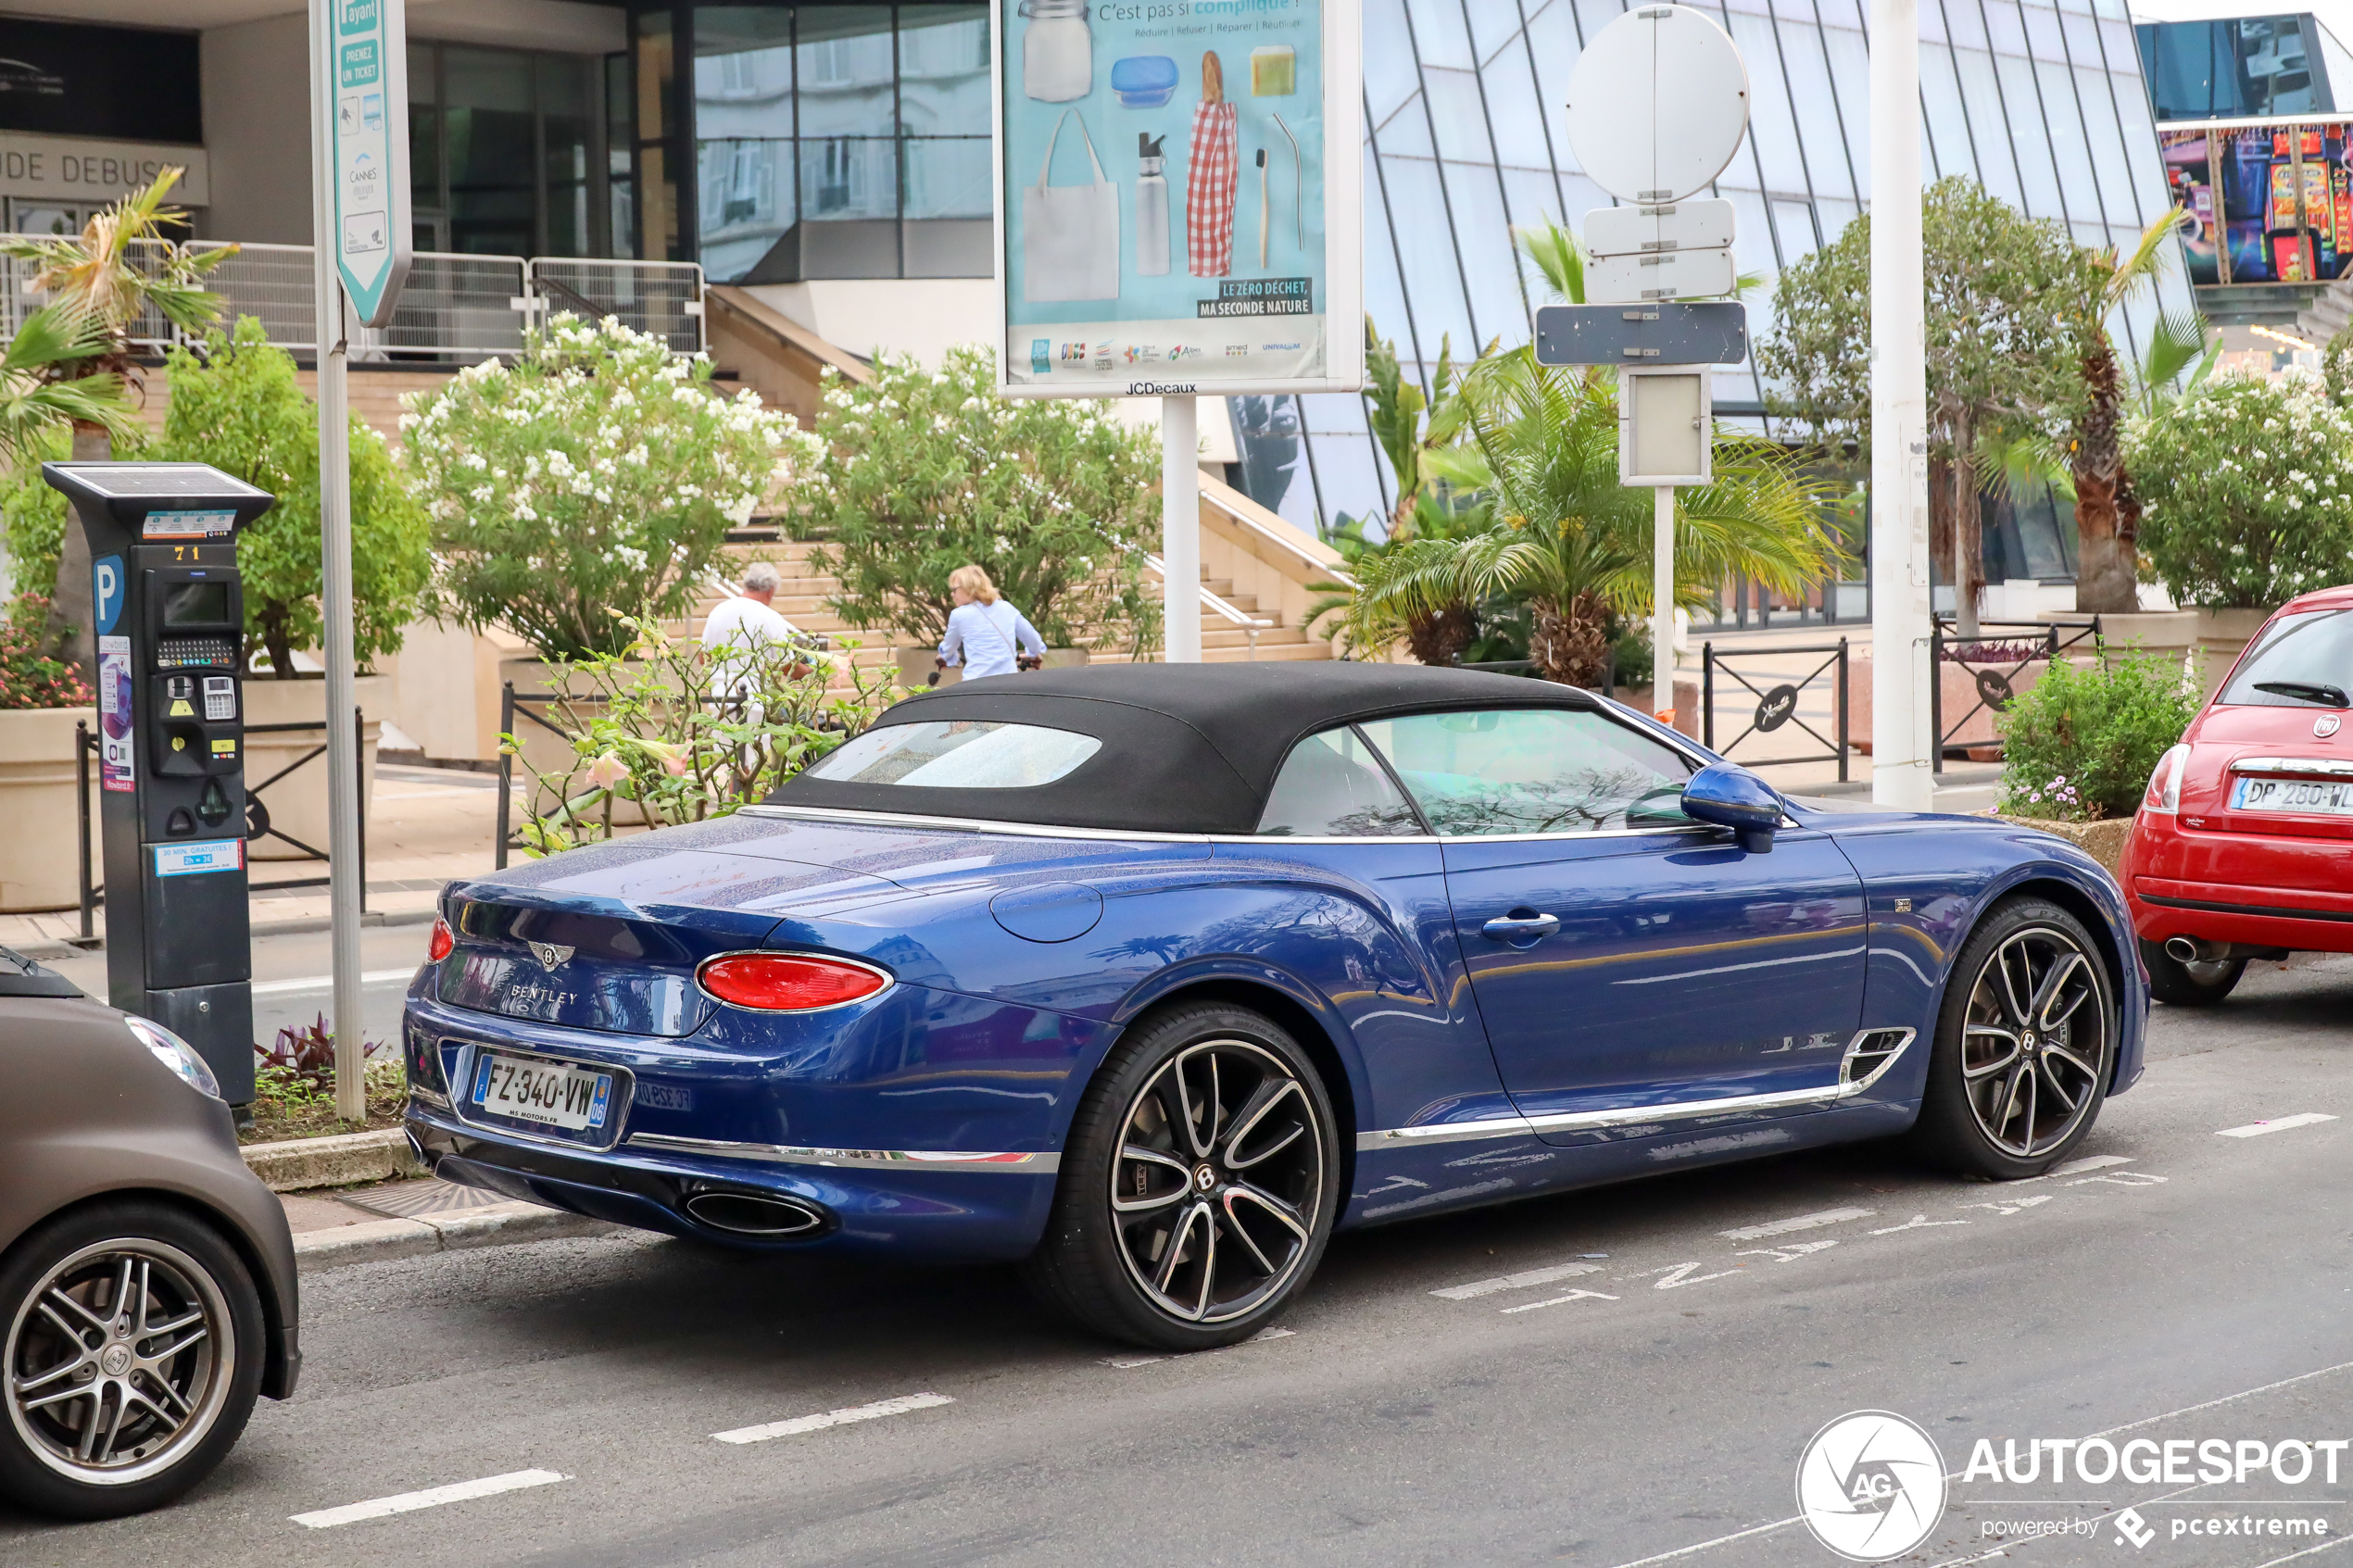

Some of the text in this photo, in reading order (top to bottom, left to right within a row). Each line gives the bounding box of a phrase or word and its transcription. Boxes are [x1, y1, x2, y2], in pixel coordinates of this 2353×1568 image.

[1147, 5, 1174, 22] pas
[1178, 3, 1189, 16] si
[1135, 28, 1168, 38] Réduire
[1176, 25, 1207, 35] Refuser
[1216, 21, 1252, 33] Réparer
[346, 46, 372, 63] PRENEZ
[342, 64, 376, 82] UN TICKET
[0, 151, 191, 190] DE DEBUSY
[349, 168, 377, 183] CANNES
[1223, 280, 1308, 296] LE ZÉRO DÉCHET,
[1201, 299, 1309, 316] MA SECONDE NATURE
[1126, 383, 1197, 395] JCDecaux
[97, 564, 116, 621] P
[2318, 721, 2335, 733] FIAT
[190, 845, 227, 854] GRATUITES
[202, 855, 212, 863] 3€
[511, 985, 578, 1005] BENTLEY
[1877, 1032, 1895, 1050] 12
[521, 1111, 558, 1123] MOTORS.FR
[591, 1102, 605, 1121] 06
[1138, 1164, 1146, 1196] TLEY
[1197, 1168, 1214, 1190] B
[106, 1349, 128, 1373] B
